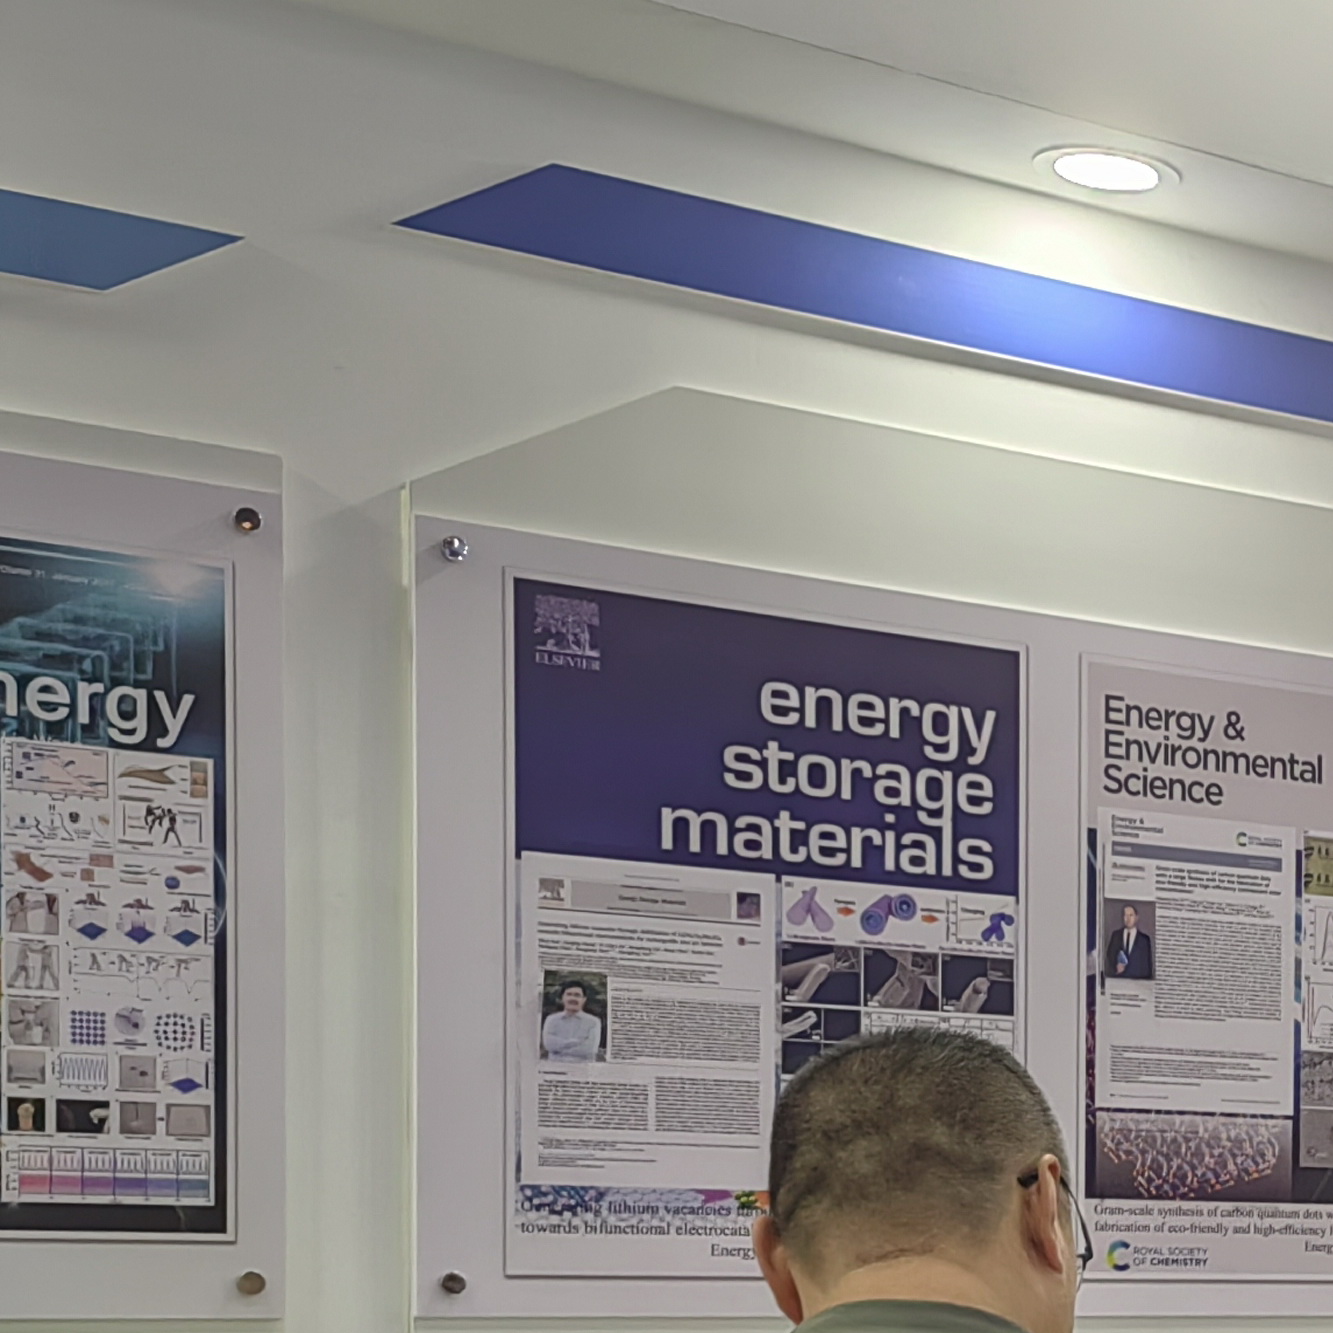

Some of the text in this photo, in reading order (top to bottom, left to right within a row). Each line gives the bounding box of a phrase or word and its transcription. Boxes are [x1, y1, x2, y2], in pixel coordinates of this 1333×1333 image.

[0, 671, 196, 748] ergy
[760, 680, 997, 766] energy
[1103, 693, 1246, 743] Energy &
[1103, 728, 1324, 785] Environmental
[722, 740, 995, 827] storage
[1102, 764, 1224, 806] Science
[660, 804, 995, 880] materials
[521, 1219, 579, 1234] towards
[584, 1220, 671, 1236] bifunctional
[608, 1198, 660, 1215] lithium
[1094, 1203, 1154, 1216] Gram-scale
[1158, 1204, 1204, 1219] synthesis
[1207, 1206, 1217, 1218] of
[1220, 1206, 1254, 1218] carbon
[1257, 1208, 1300, 1221] quantum
[1303, 1209, 1323, 1220] dots
[1095, 1220, 1150, 1233] fabrication
[1154, 1221, 1166, 1233] of
[1168, 1221, 1229, 1237] eco-friendly
[1232, 1223, 1251, 1235] and
[1254, 1223, 1326, 1238] high-efficiency
[1133, 1246, 1208, 1257] ROYAL SOCIETY
[1133, 1257, 1208, 1267] OF CHEMISTRY
